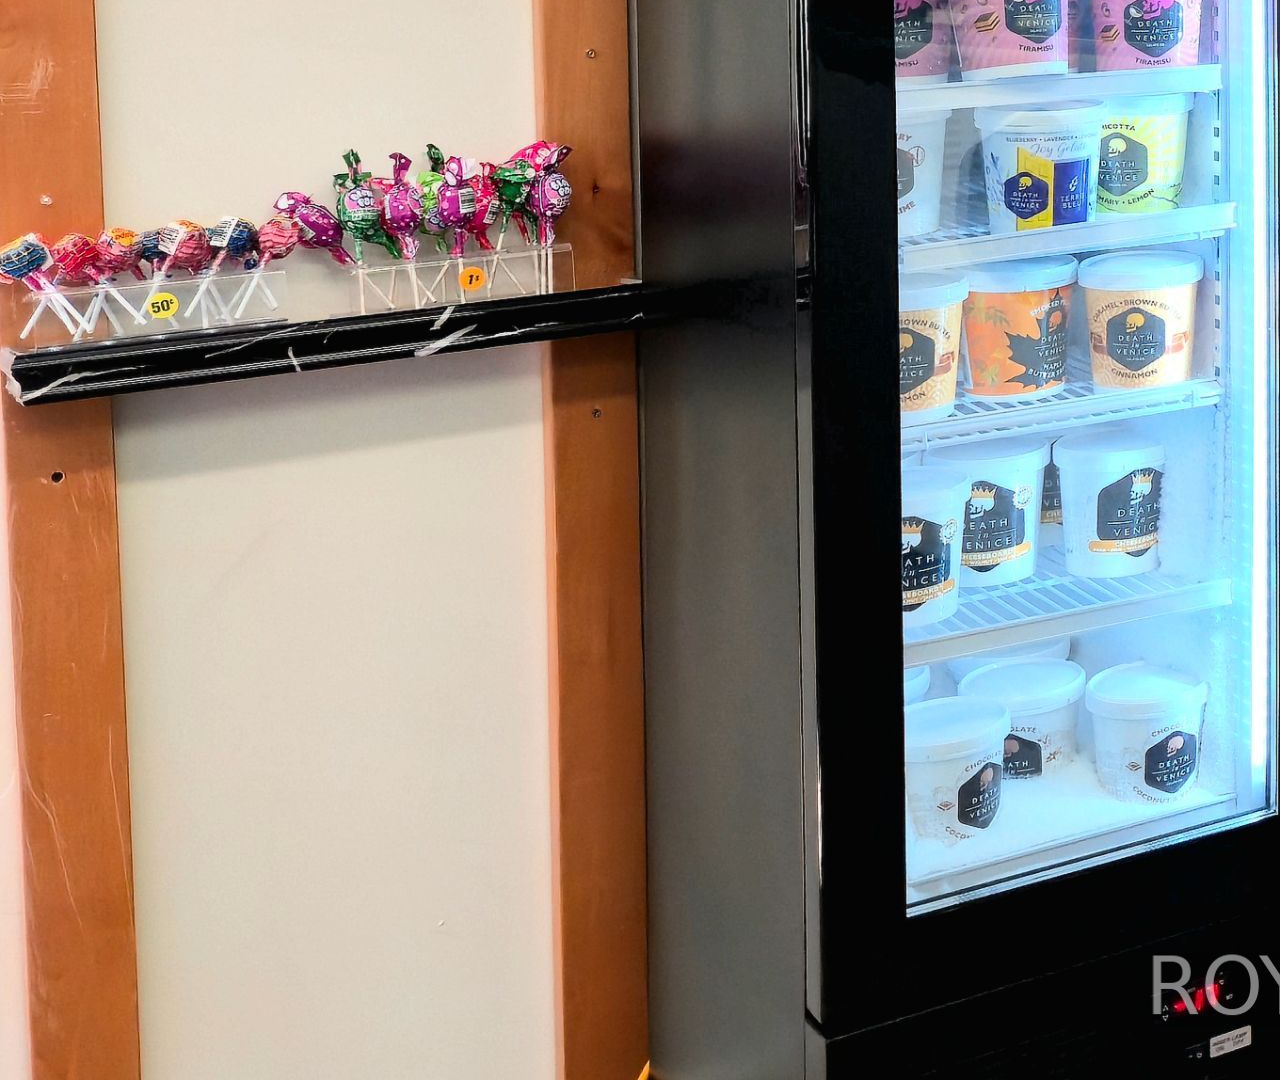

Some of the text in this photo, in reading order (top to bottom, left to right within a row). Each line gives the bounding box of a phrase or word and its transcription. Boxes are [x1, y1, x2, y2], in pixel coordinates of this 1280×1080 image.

[1018, 44, 1054, 53] TIRAMISU
[1136, 57, 1171, 65] TIRAMISU
[1128, 188, 1155, 205] LEMON
[898, 201, 916, 215] IME
[151, 298, 175, 314] 50¢
[1093, 299, 1158, 322] CARAMEL BROWN
[1118, 333, 1153, 341] DEATH
[1111, 368, 1158, 379] CINNAMON
[1118, 504, 1160, 517] DEATH
[964, 518, 1008, 530] EATH
[1114, 522, 1155, 536] VENIC
[966, 537, 1012, 549] ENICE
[905, 554, 935, 567] ATH
[902, 574, 937, 587] NICE
[1159, 754, 1190, 768] DEATH
[1156, 767, 1190, 781] VENICE
[1133, 786, 1170, 803] COCONUT
